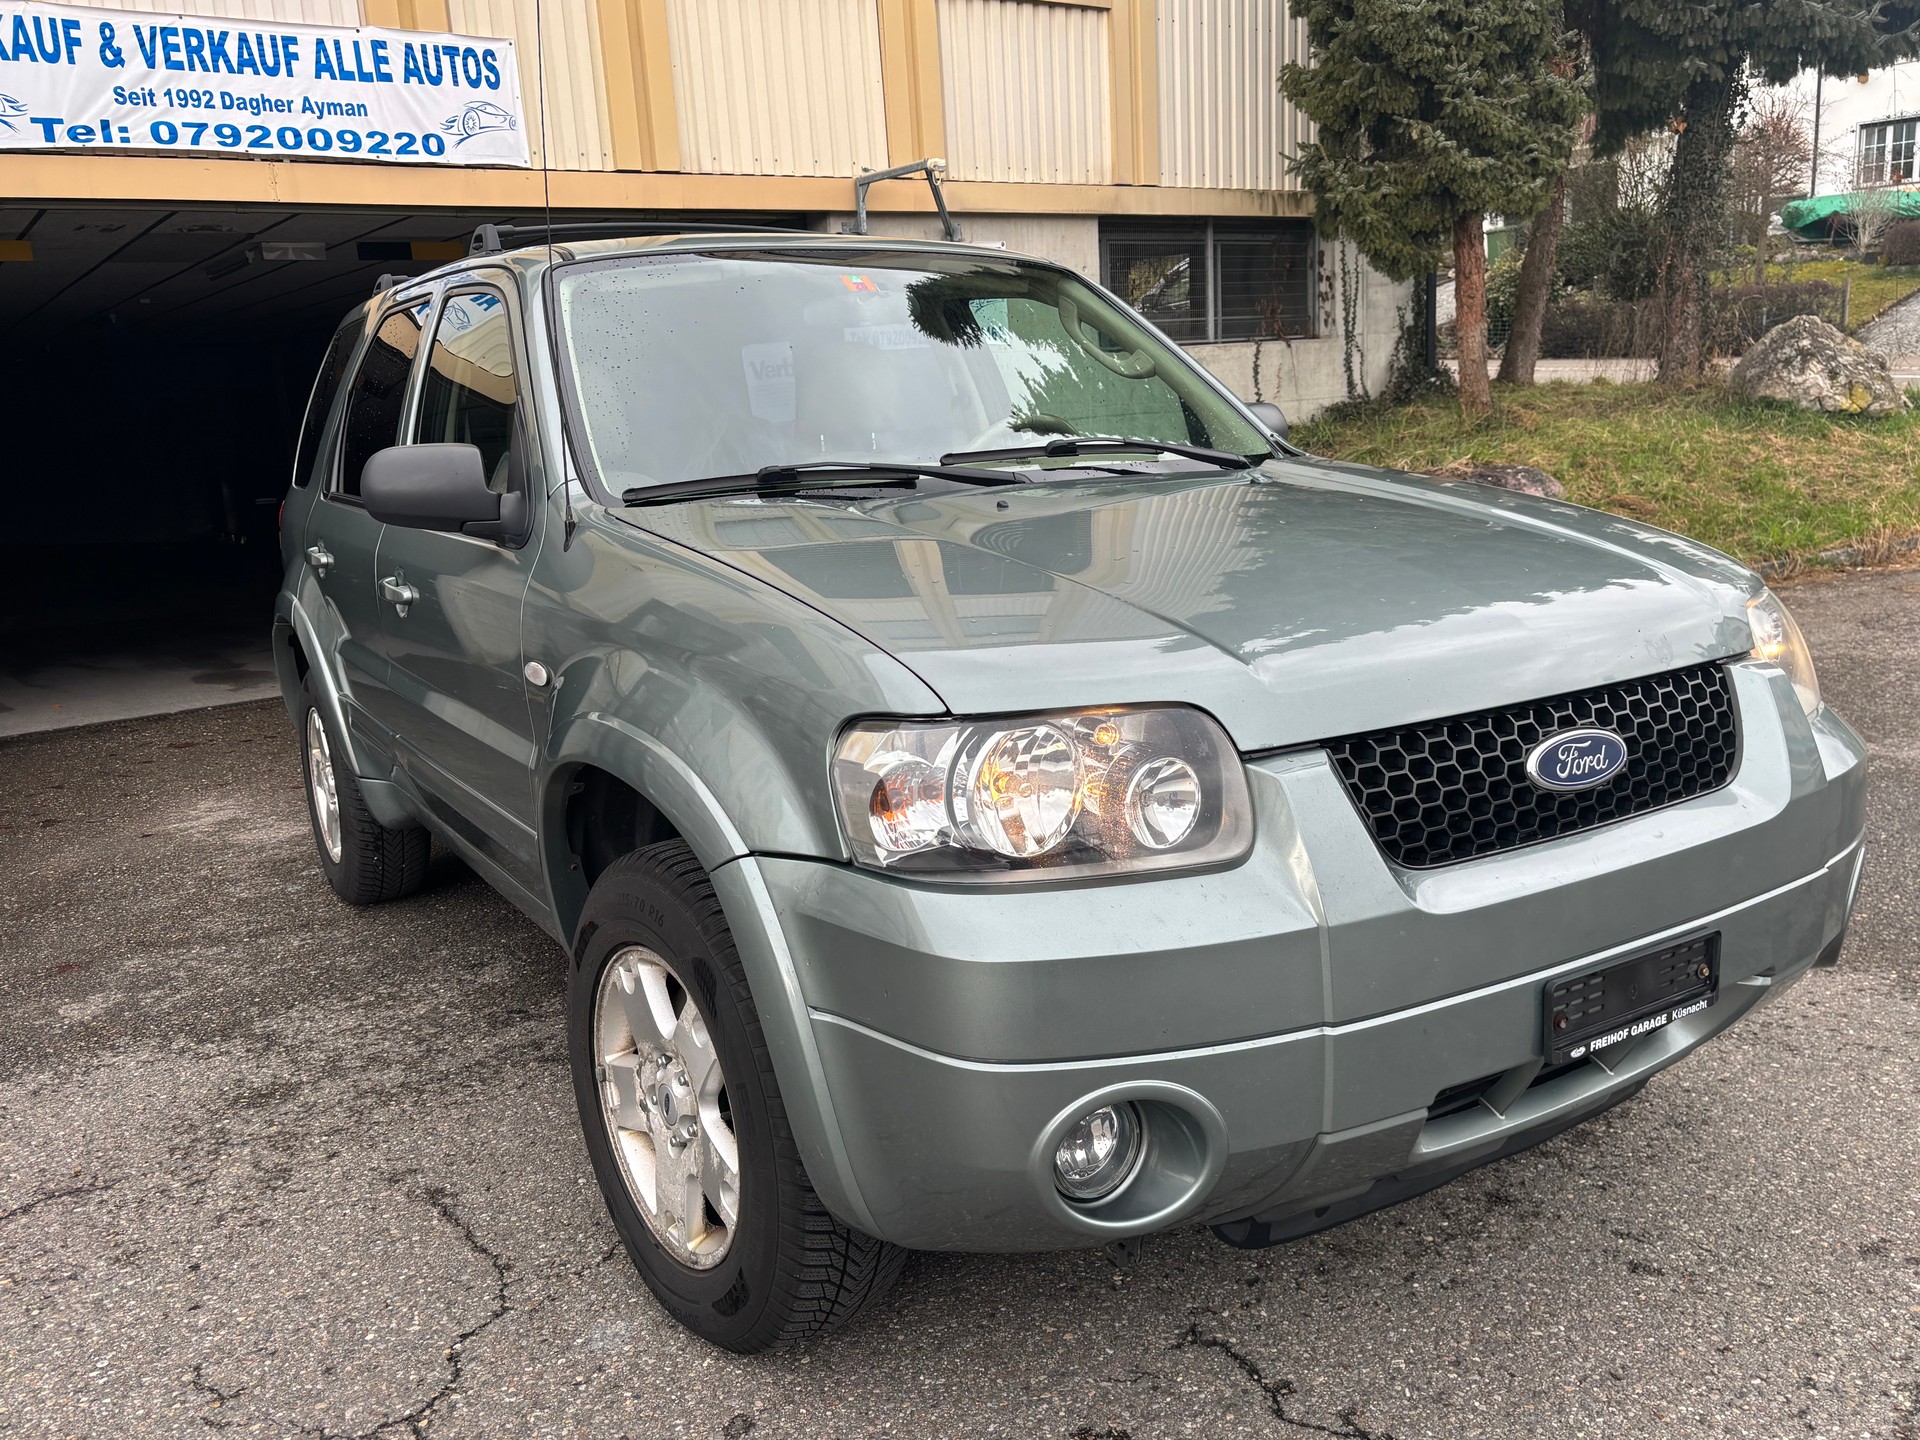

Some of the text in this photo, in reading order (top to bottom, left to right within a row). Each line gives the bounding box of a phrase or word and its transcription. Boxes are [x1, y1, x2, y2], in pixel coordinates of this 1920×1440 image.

[98, 21, 126, 69] &
[133, 24, 300, 78] VERKAUF
[314, 37, 394, 83] ALLE
[403, 42, 501, 91] AUTOS
[113, 85, 368, 120] Seit 1992 Dagher Ayman
[30, 116, 446, 157] Tel: 0792009220
[1556, 740, 1609, 778] Ford
[1590, 1028, 1630, 1052] FREIHOF
[1630, 1013, 1668, 1036] GARAGE
[1671, 999, 1708, 1021] Küsnacht
